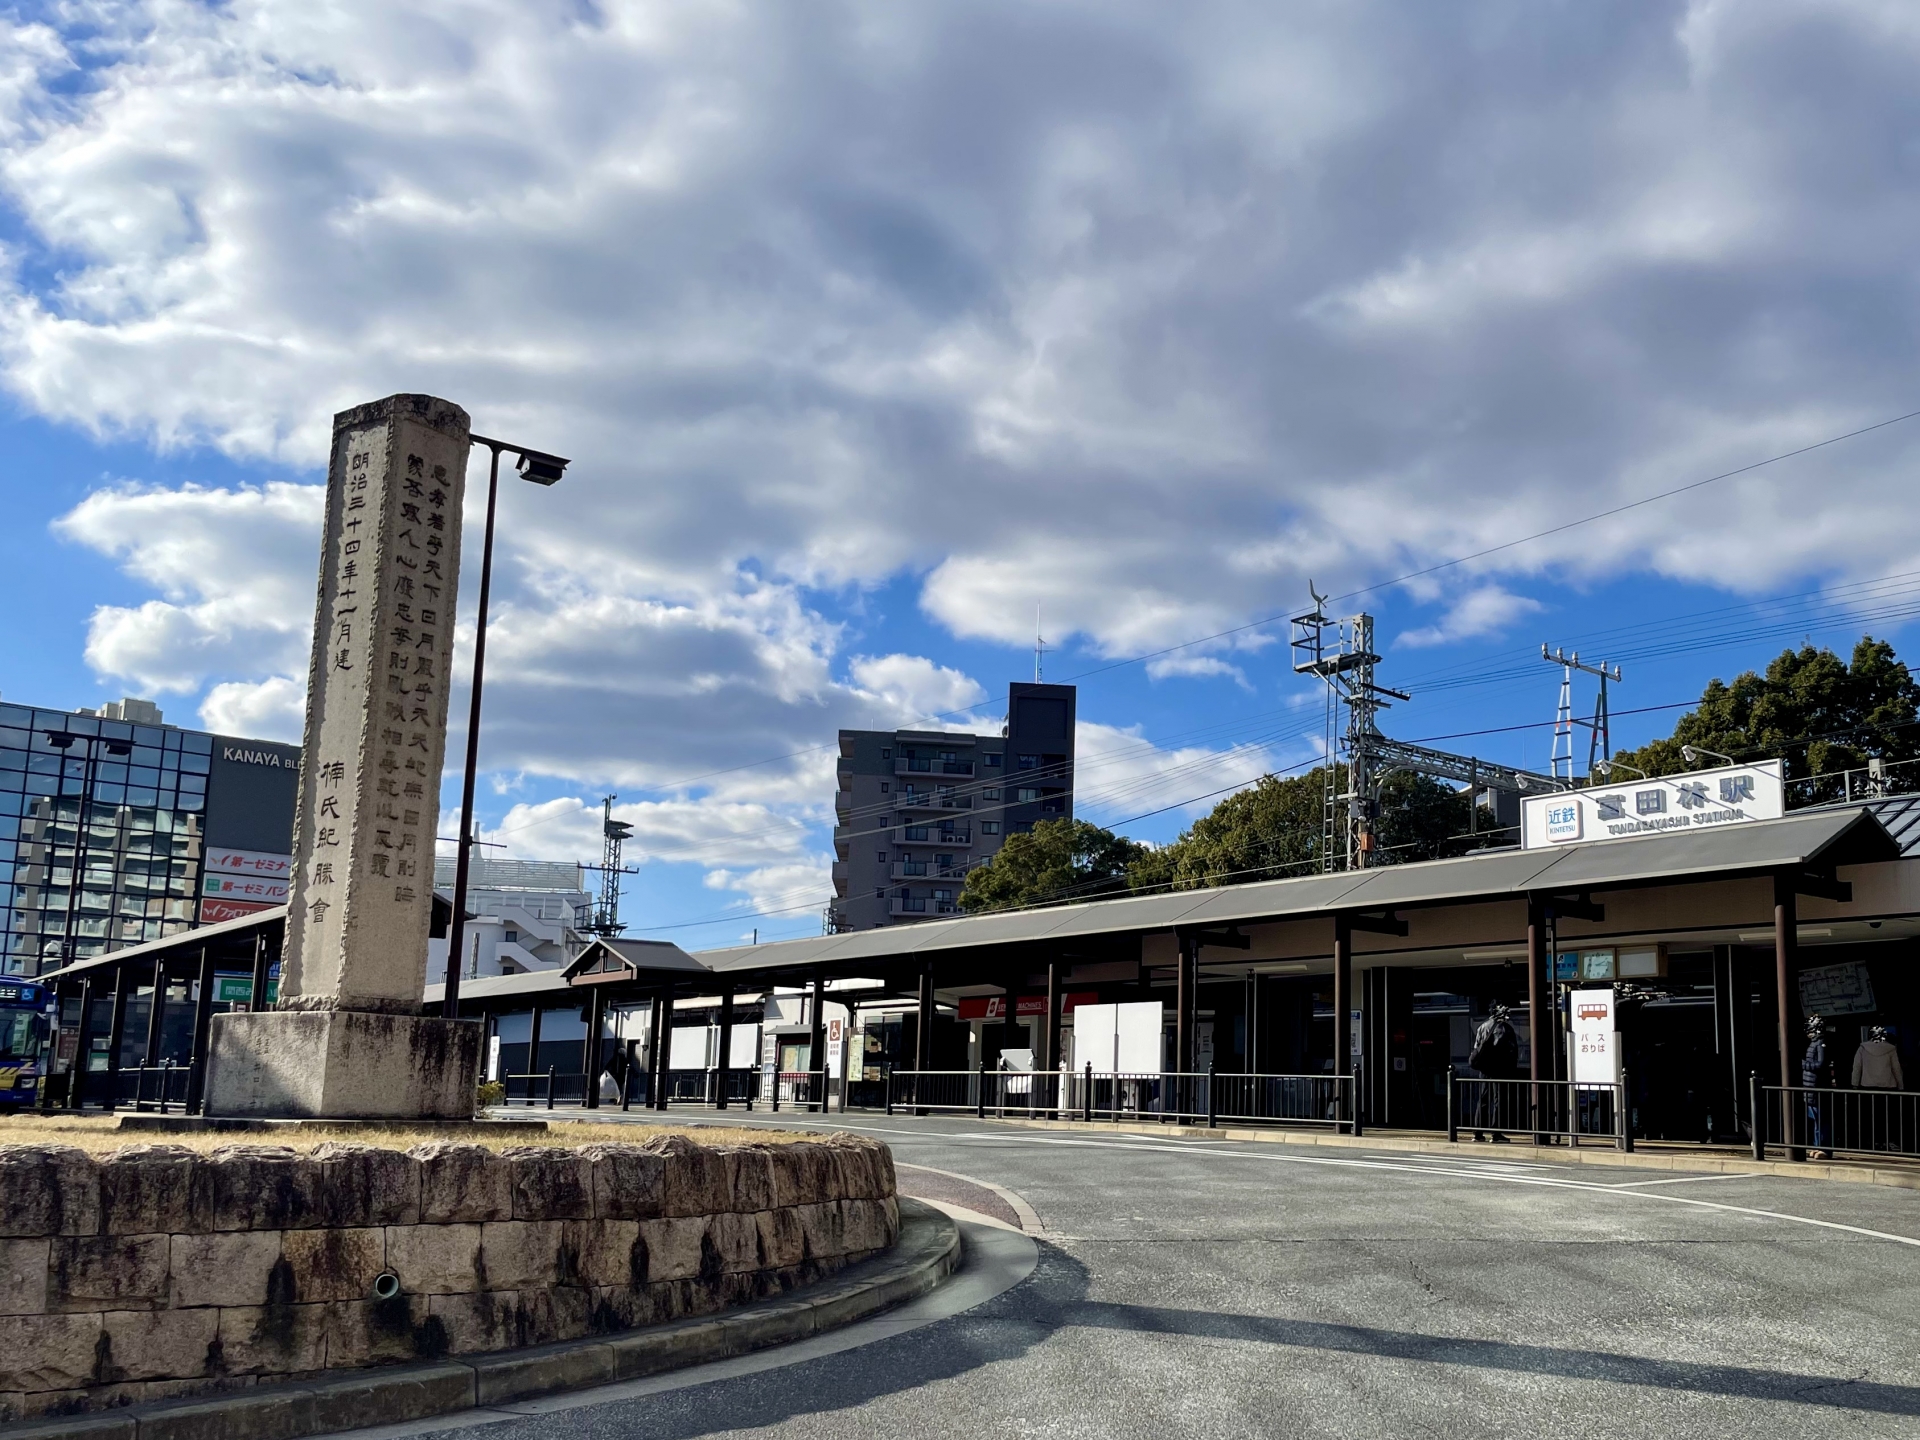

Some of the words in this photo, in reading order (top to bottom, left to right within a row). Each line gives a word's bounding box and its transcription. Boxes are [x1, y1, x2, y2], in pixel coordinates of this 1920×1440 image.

[223, 747, 280, 767] KANAYA
[1596, 774, 1756, 821] 富田林駅
[1548, 807, 1576, 824] 近鉄
[1606, 815, 1690, 835] TONDABAYASHI
[1692, 808, 1744, 823] STATION
[1549, 824, 1576, 835] KINTETSU
[1581, 1033, 1605, 1041] バス
[1581, 1044, 1605, 1053] おりば
